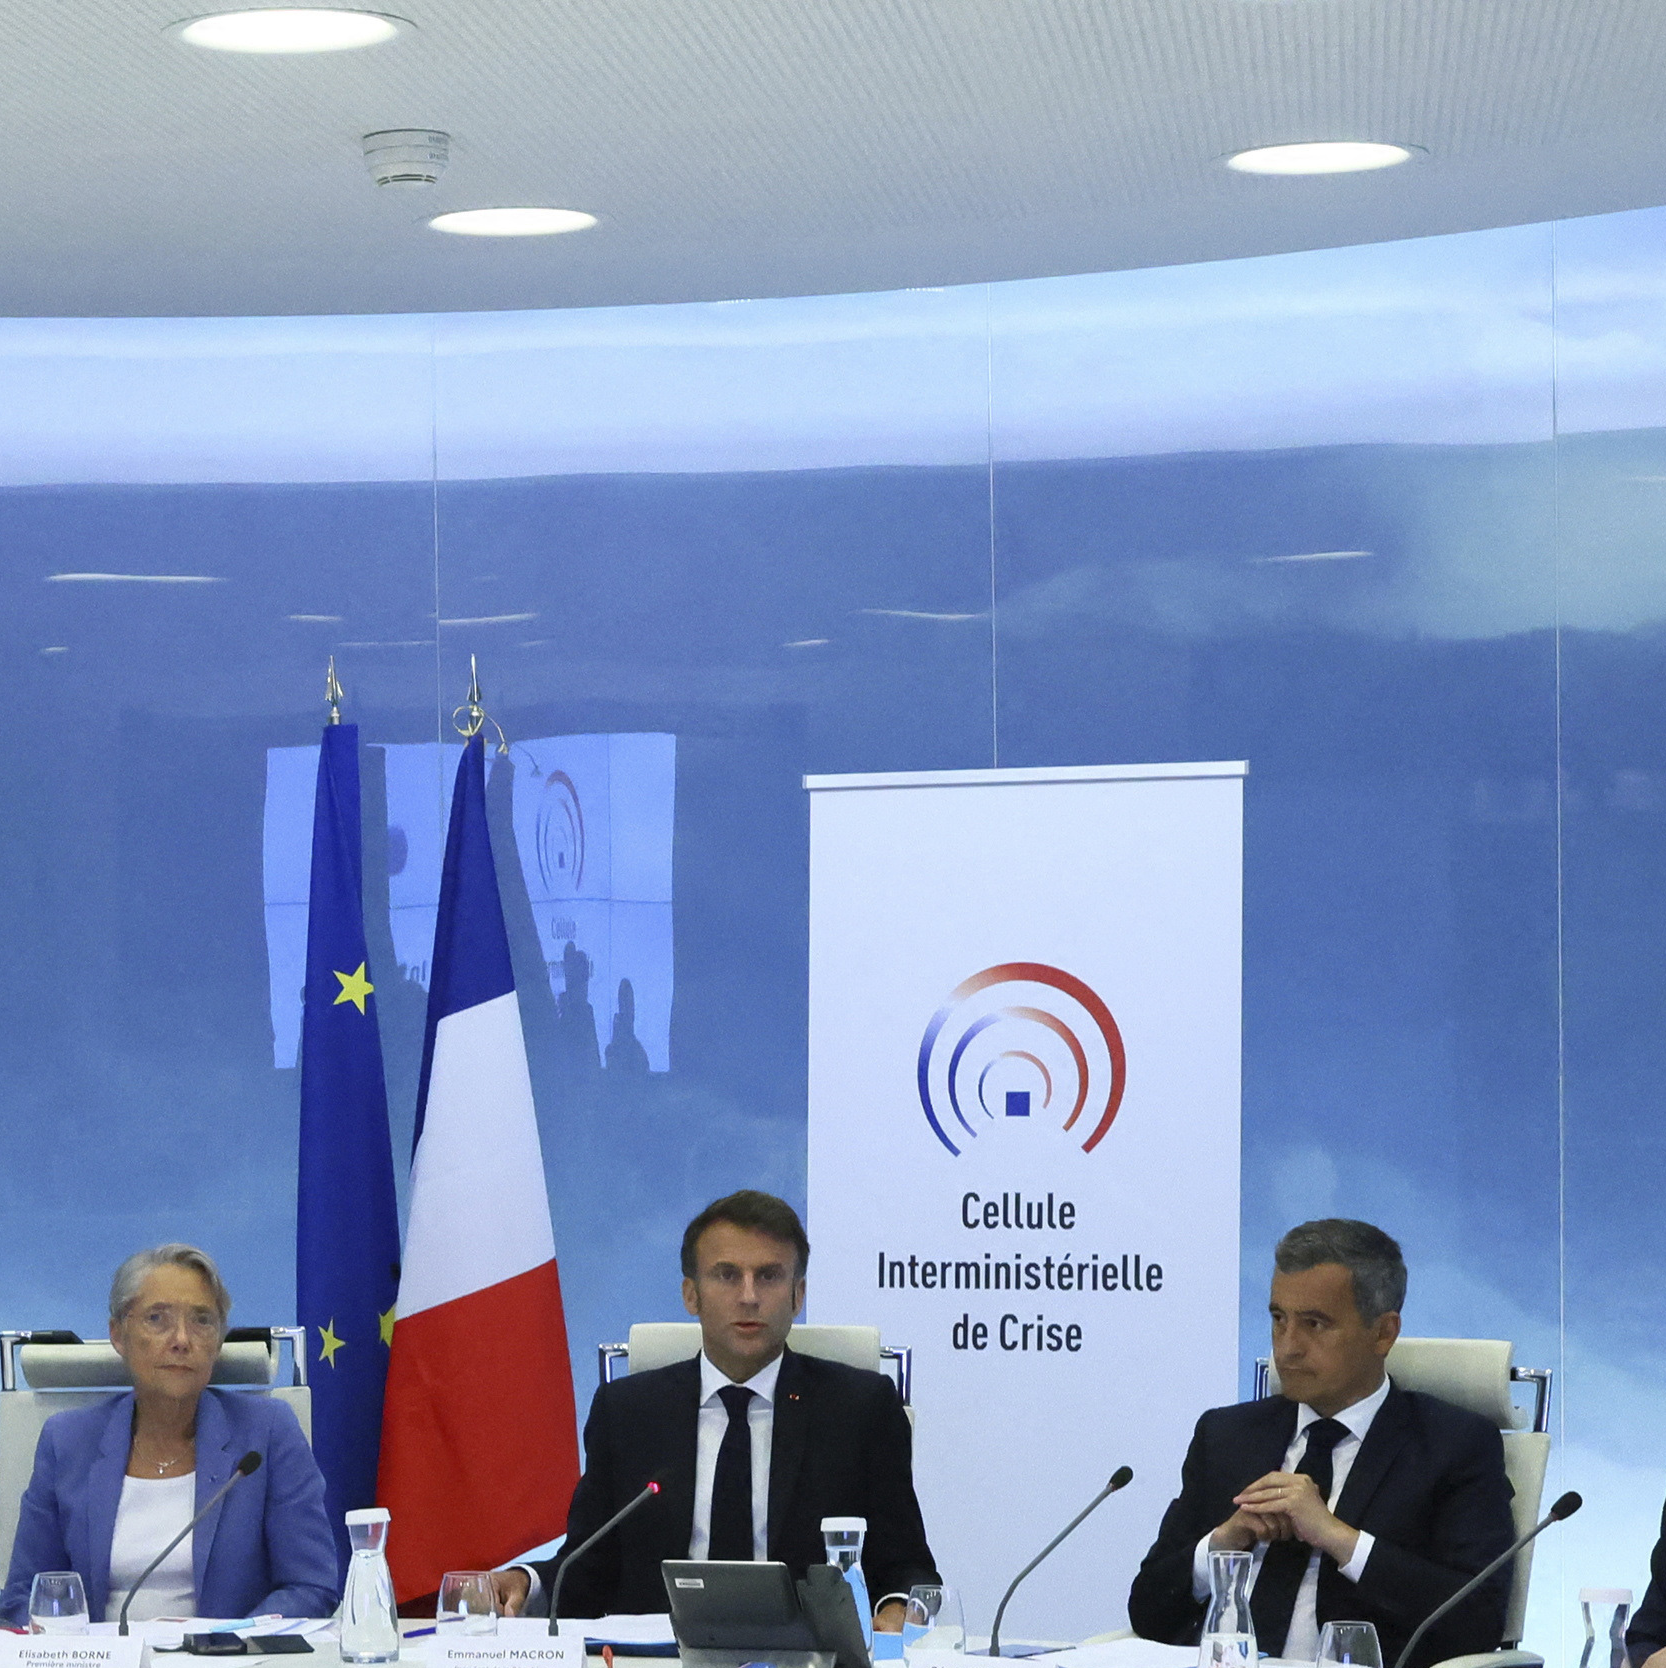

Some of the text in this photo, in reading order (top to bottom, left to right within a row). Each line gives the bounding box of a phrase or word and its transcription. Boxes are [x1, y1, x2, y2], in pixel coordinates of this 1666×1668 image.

[961, 1192, 1076, 1230] Cellule
[878, 1252, 1164, 1292] Interministérielle
[952, 1313, 1083, 1352] de Crise
[18, 1649, 112, 1660] Elisabeth BORNE
[26, 1660, 101, 1668] Première ministre
[447, 1650, 564, 1660] Emmanuel MACRON
